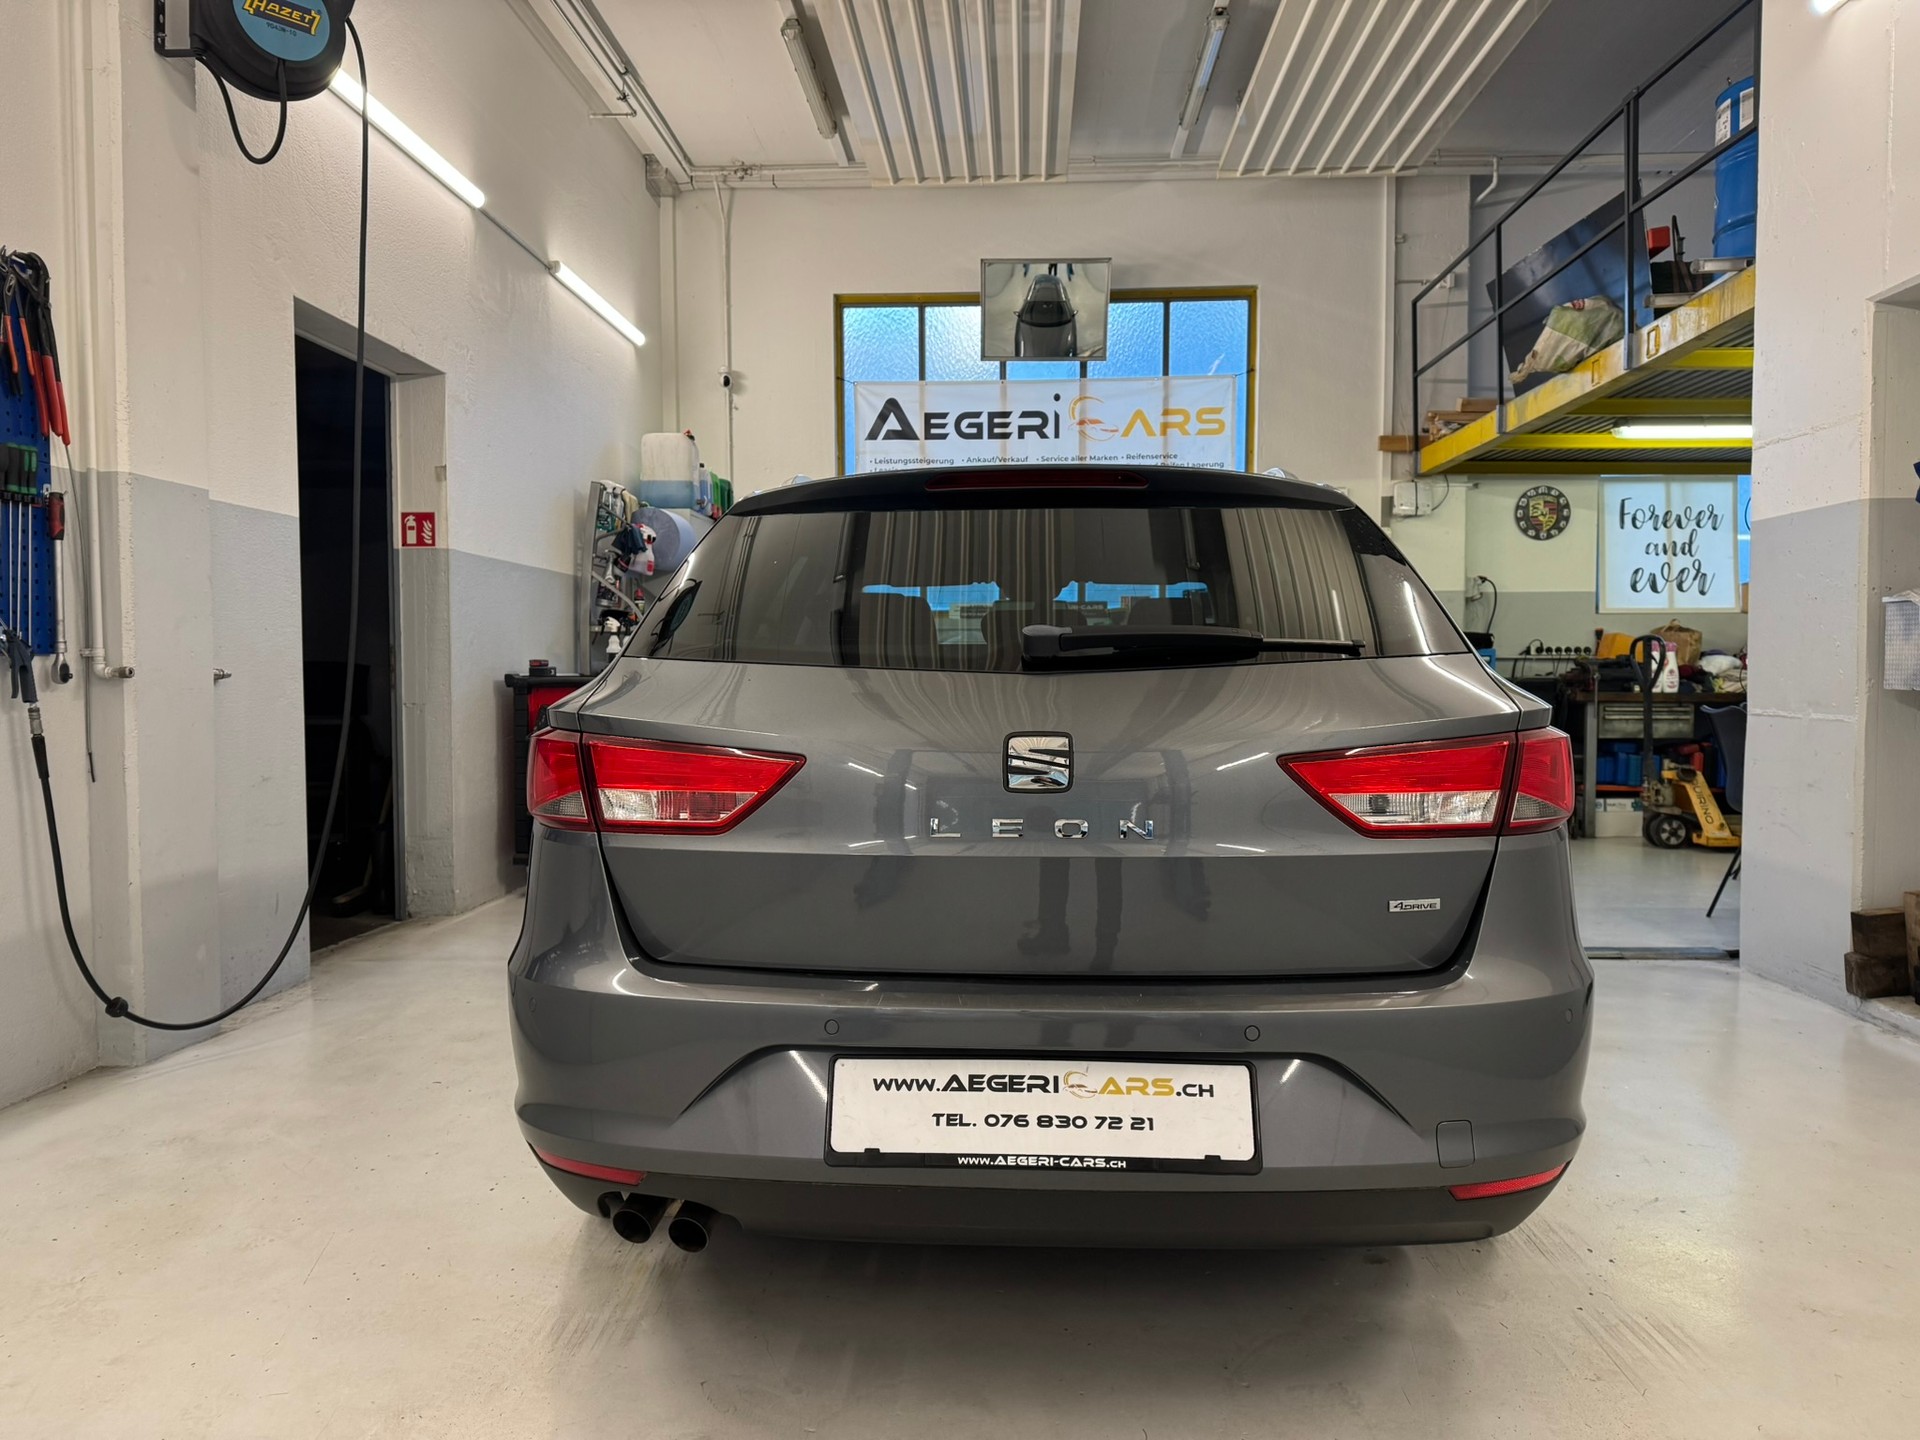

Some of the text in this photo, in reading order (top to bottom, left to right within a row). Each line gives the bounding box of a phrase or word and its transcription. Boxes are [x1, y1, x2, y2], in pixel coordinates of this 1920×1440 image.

[252, 0, 314, 23] HAZET
[874, 457, 954, 465] Leistungssteigerung
[1619, 497, 1724, 531] Forever
[1645, 529, 1699, 558] and
[1630, 559, 1716, 596] ever
[929, 817, 1154, 840] LEON
[1393, 901, 1438, 910] 4DRIVE
[931, 1112, 1154, 1131] TEL. 076 830 72 21
